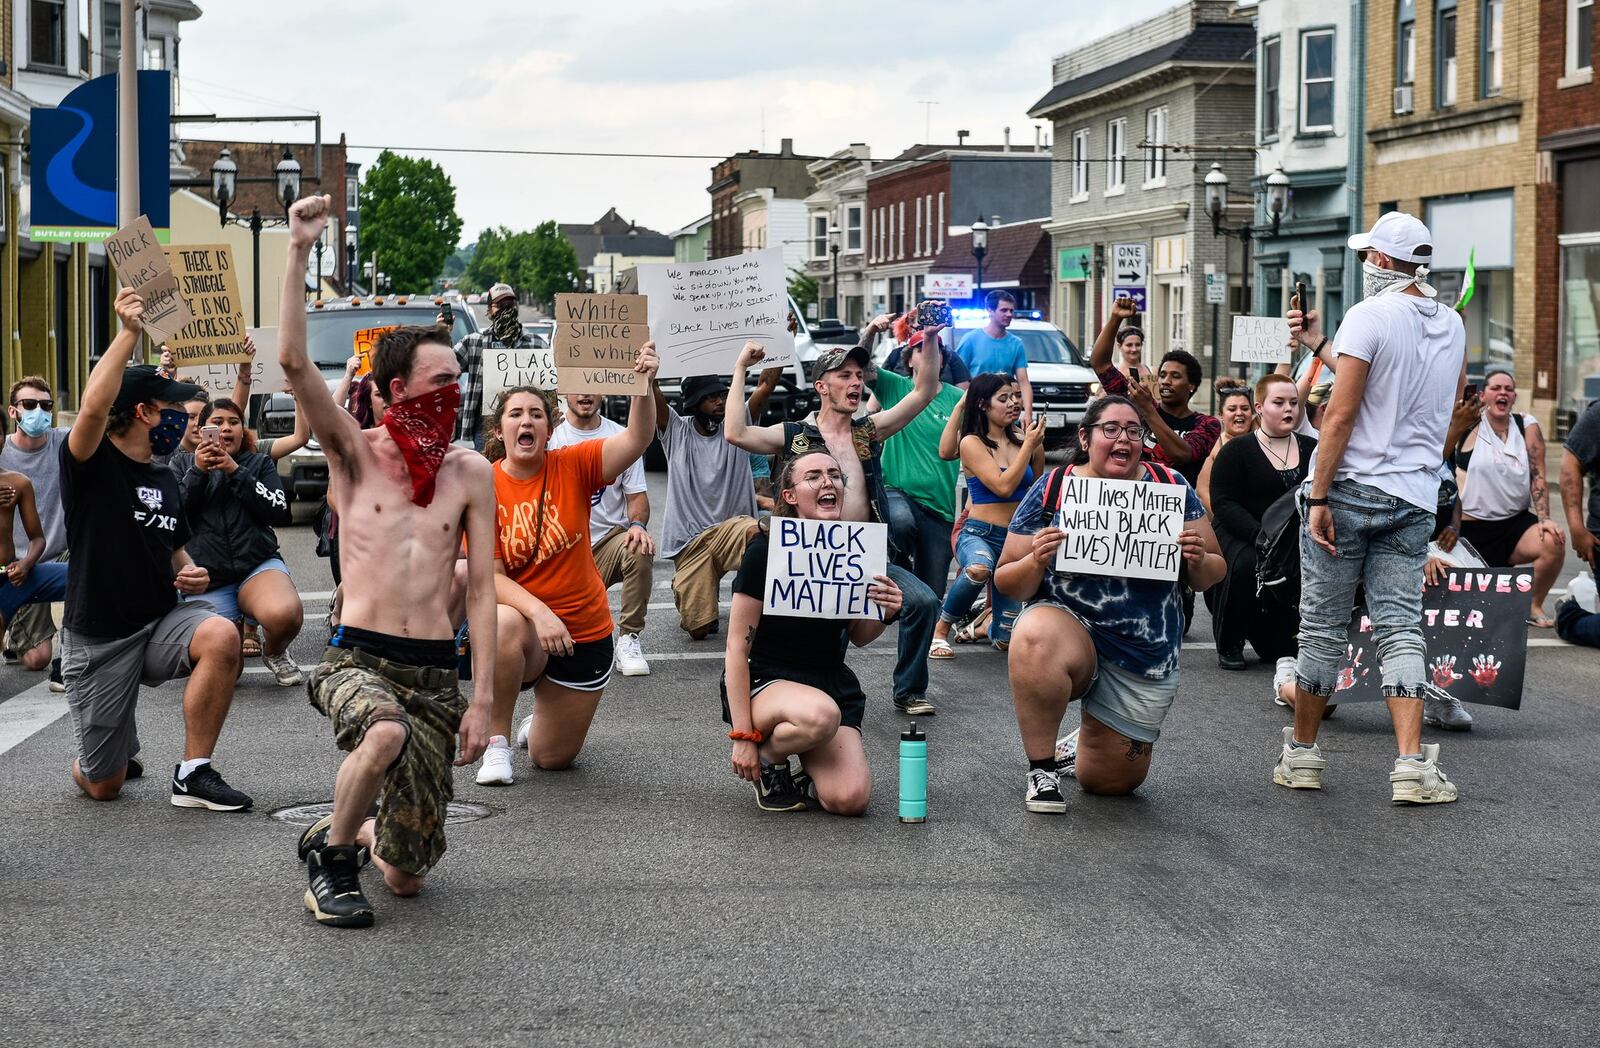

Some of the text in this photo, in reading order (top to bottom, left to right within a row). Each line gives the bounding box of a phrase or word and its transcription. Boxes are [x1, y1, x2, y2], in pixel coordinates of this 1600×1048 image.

[34, 230, 112, 239] BUTLER COUNTY
[107, 230, 151, 268] Black
[1118, 247, 1141, 257] ONE
[179, 250, 213, 272] THERE
[215, 250, 229, 271] IS
[1117, 259, 1141, 268] WAY
[184, 274, 226, 294] STRUGGLE
[666, 269, 683, 280] We
[957, 280, 966, 288] Z
[201, 297, 212, 315] IS
[214, 296, 231, 315] NO
[672, 293, 686, 301] We
[566, 298, 629, 321] White
[709, 320, 739, 331] Lives
[1235, 317, 1281, 336] BLACK
[1247, 336, 1282, 349] LIVES
[497, 353, 552, 371] BLAC
[593, 344, 641, 361] white
[503, 370, 558, 388] LIVES
[1064, 478, 1183, 514] All lives MATTER
[1062, 510, 1172, 537] WHEN BLACK
[781, 519, 866, 554] BLACK
[1064, 533, 1179, 573] LIVES MATTER
[788, 551, 864, 582] LIVES
[1448, 572, 1532, 593] LIVES
